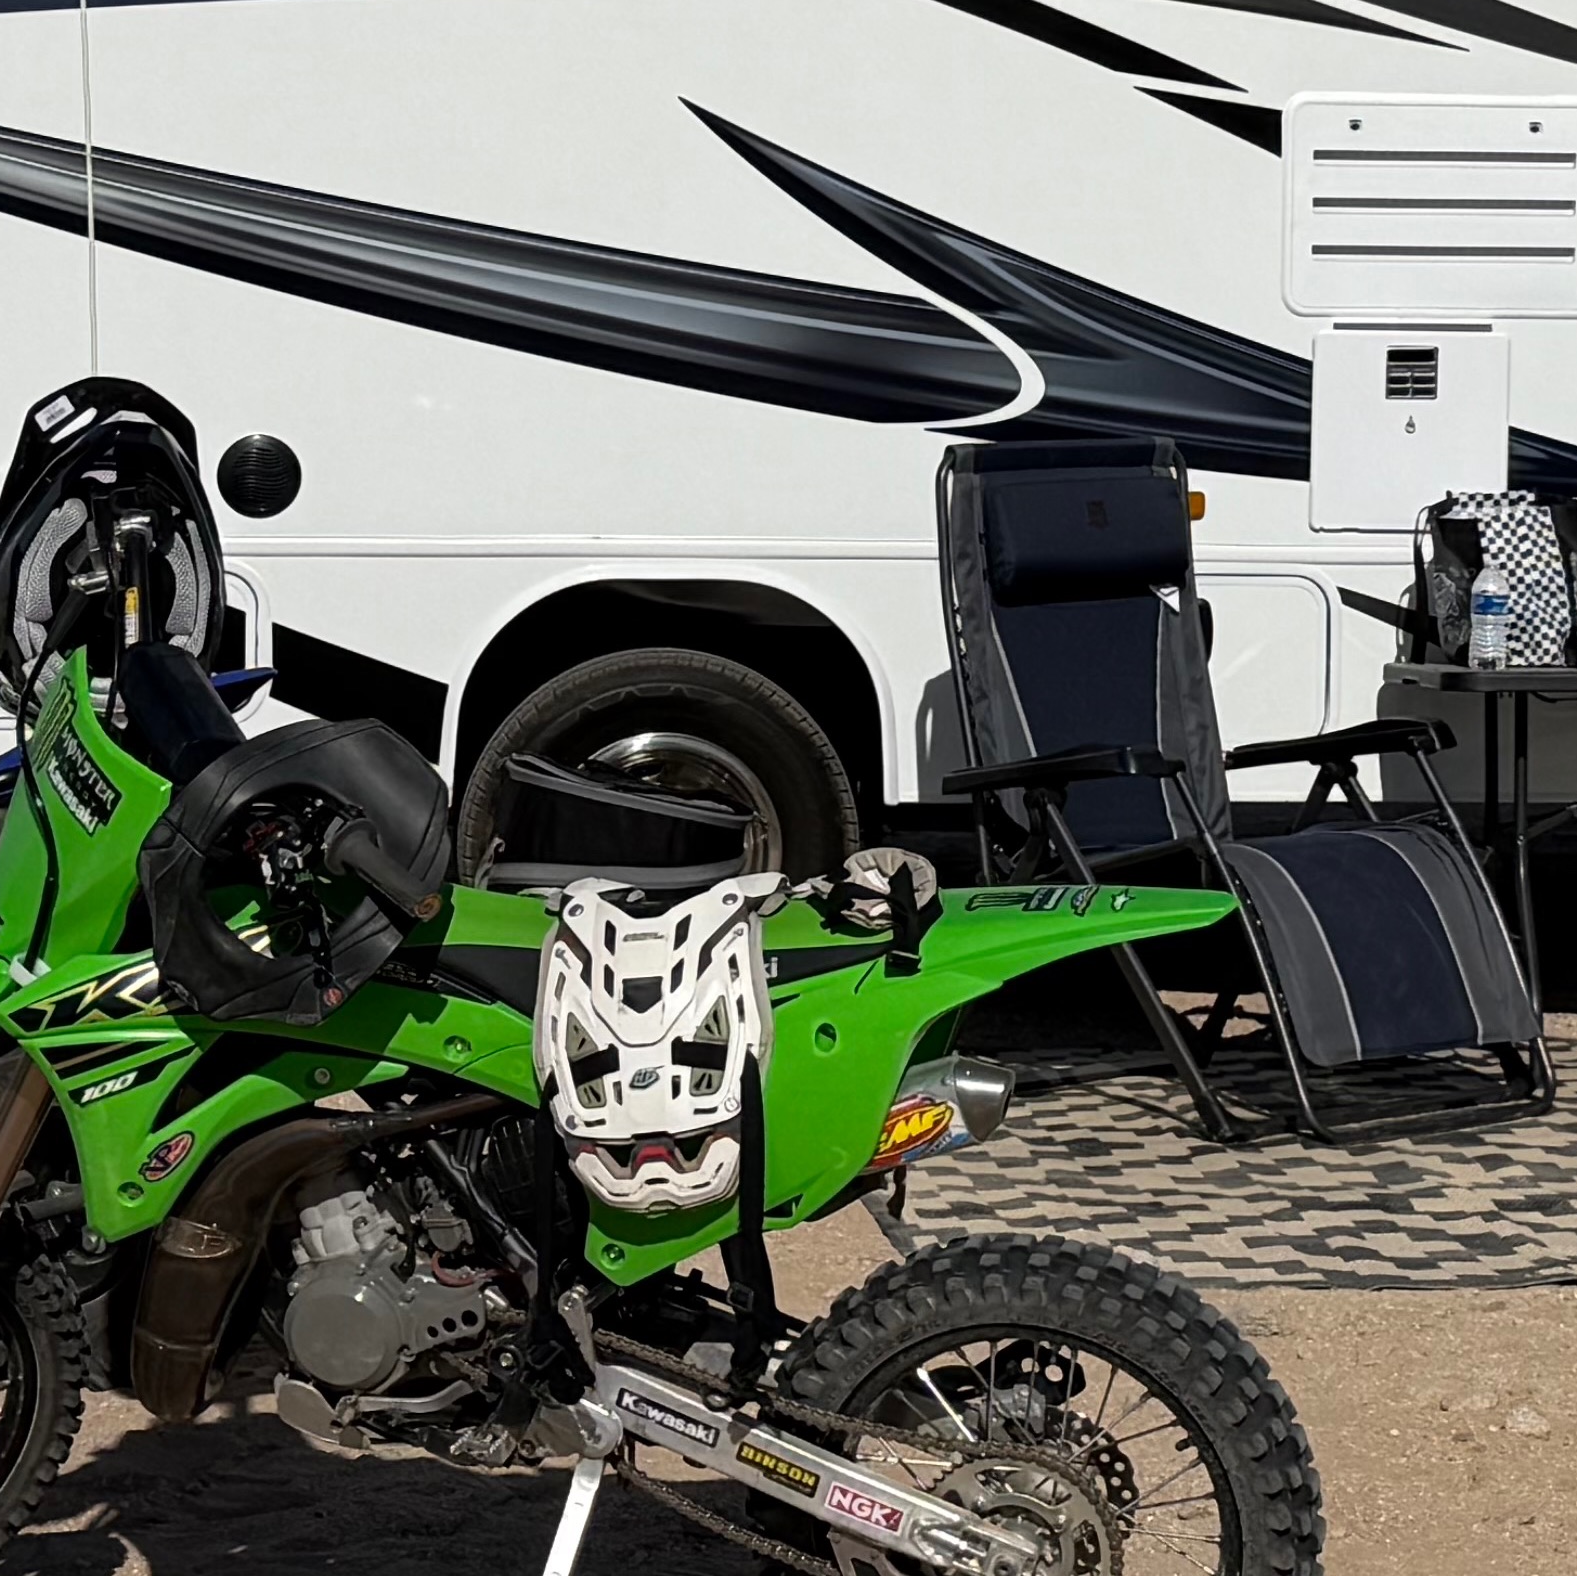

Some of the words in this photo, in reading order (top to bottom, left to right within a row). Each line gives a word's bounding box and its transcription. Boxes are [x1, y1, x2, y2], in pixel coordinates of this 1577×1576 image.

[60, 725, 116, 811] MONSTER
[80, 1071, 138, 1103] 100
[621, 1392, 716, 1445] Kawasaki
[830, 1485, 892, 1525] NGK
